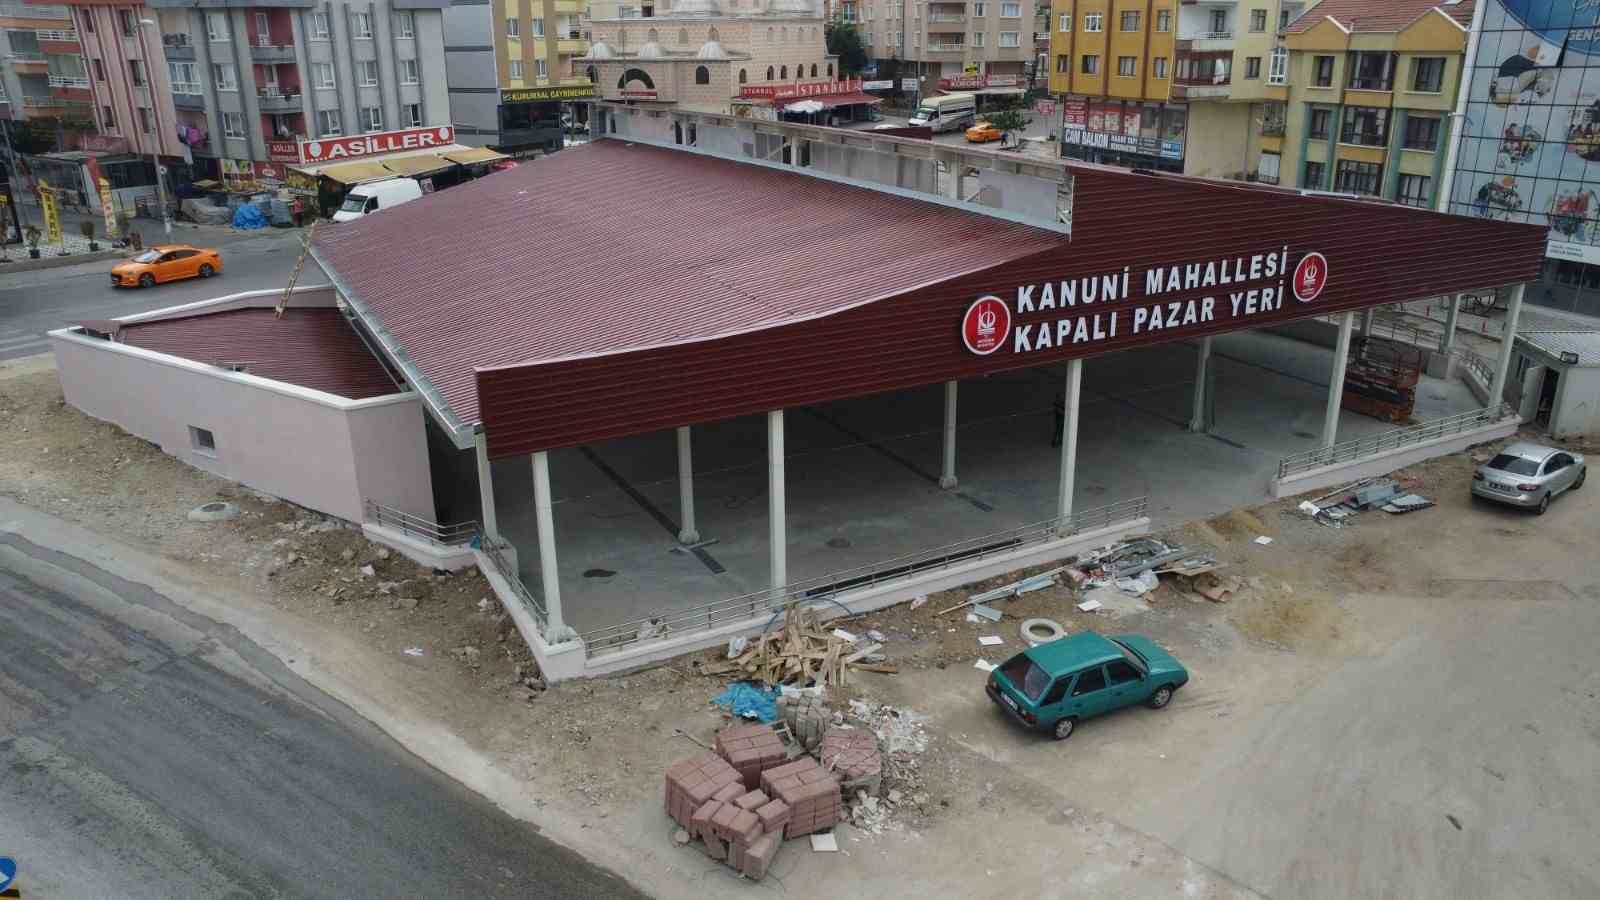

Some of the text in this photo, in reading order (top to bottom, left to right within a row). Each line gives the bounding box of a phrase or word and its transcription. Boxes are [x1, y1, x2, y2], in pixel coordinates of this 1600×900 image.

[329, 132, 434, 157] ASİLLER
[1017, 245, 1288, 313] KANUNİ MAHALLESİ
[1014, 279, 1285, 353] KAPALI PAZAR YERİ
